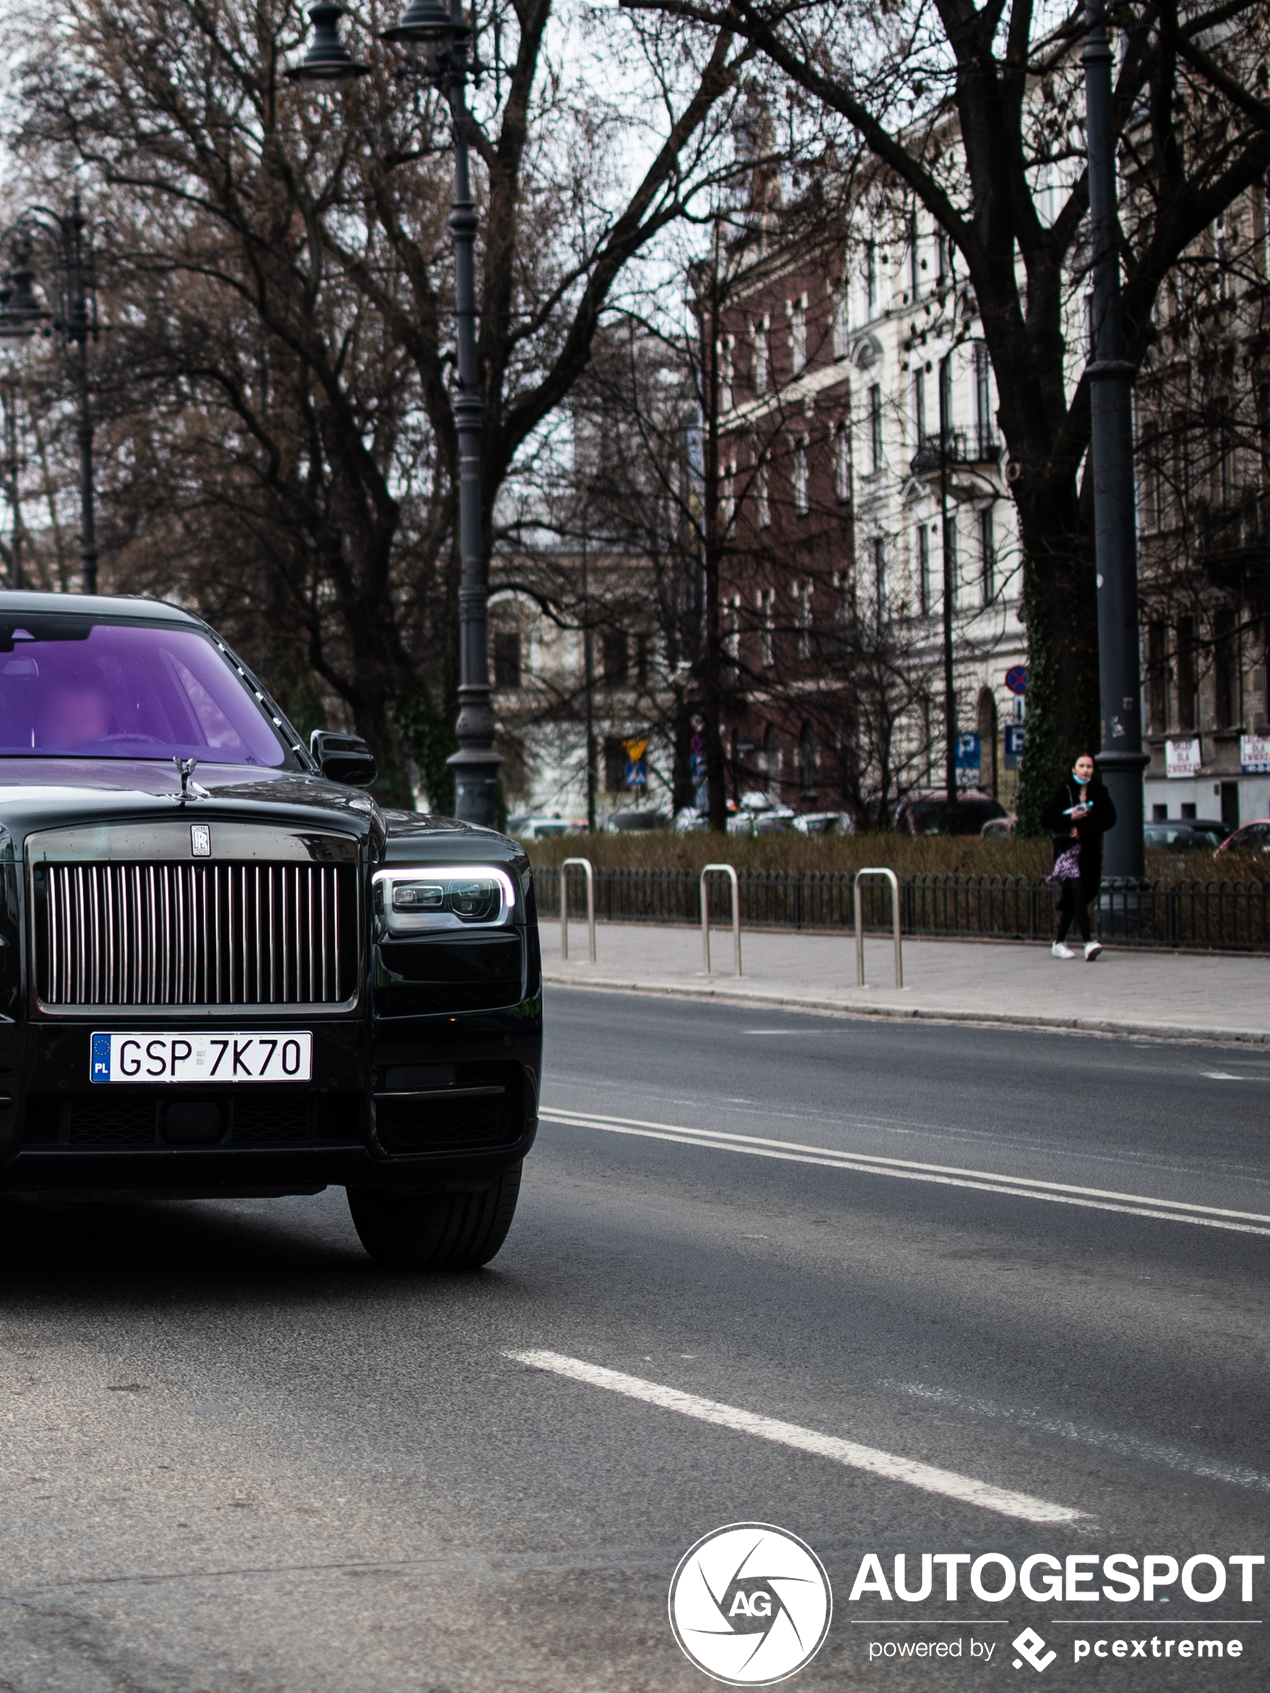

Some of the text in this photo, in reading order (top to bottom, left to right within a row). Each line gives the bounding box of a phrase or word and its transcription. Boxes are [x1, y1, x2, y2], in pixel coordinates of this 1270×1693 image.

[94, 1062, 109, 1074] PL
[119, 1039, 301, 1077] GSP 7K70
